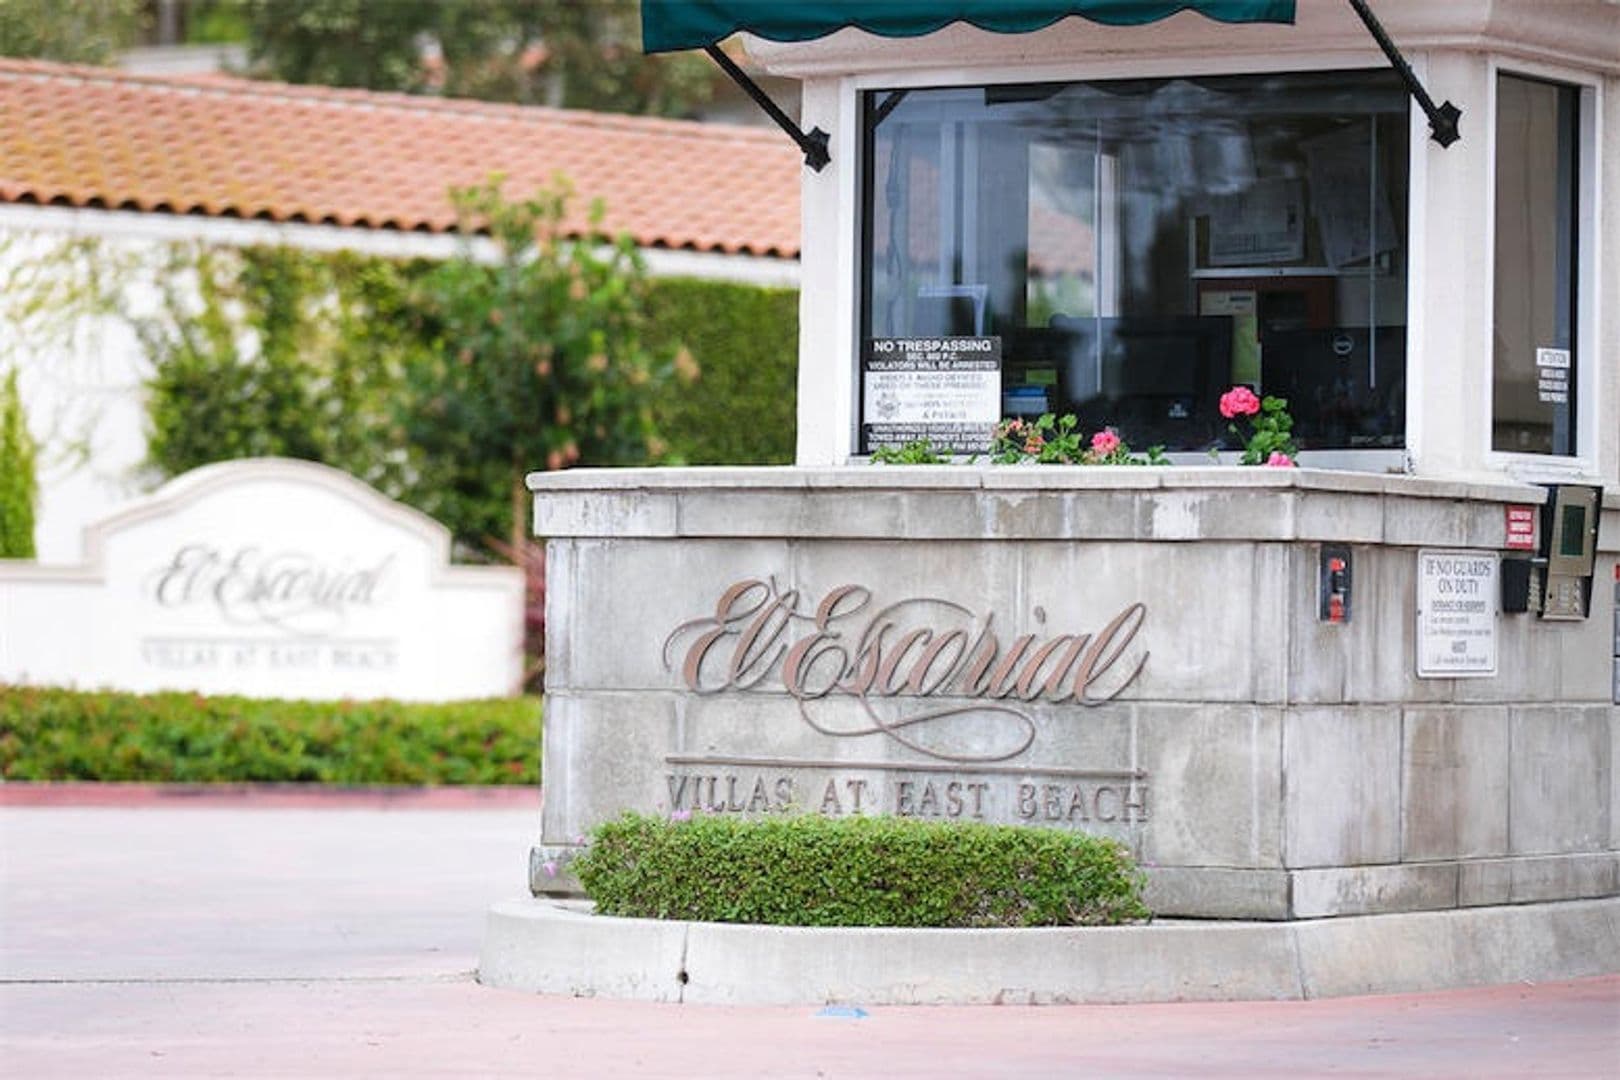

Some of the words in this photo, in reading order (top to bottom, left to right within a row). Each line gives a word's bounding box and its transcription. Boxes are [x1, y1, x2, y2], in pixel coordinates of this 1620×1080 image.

[873, 339, 895, 352] NO
[897, 339, 992, 352] TRESPASSING
[868, 361, 916, 370] VIOLATORS
[917, 361, 937, 370] WILL
[939, 361, 951, 370] BE
[952, 361, 998, 370] ARRESTED
[1426, 559, 1435, 575] IF
[1436, 560, 1452, 576] NO
[1453, 560, 1492, 577] GUARDS
[1439, 578, 1454, 594] ON
[663, 575, 800, 696] El
[783, 585, 1149, 761] Escorial
[665, 774, 794, 813] VILLAS
[822, 777, 868, 815] AT
[896, 780, 988, 817] EAST
[1017, 783, 1149, 823] BEACH
